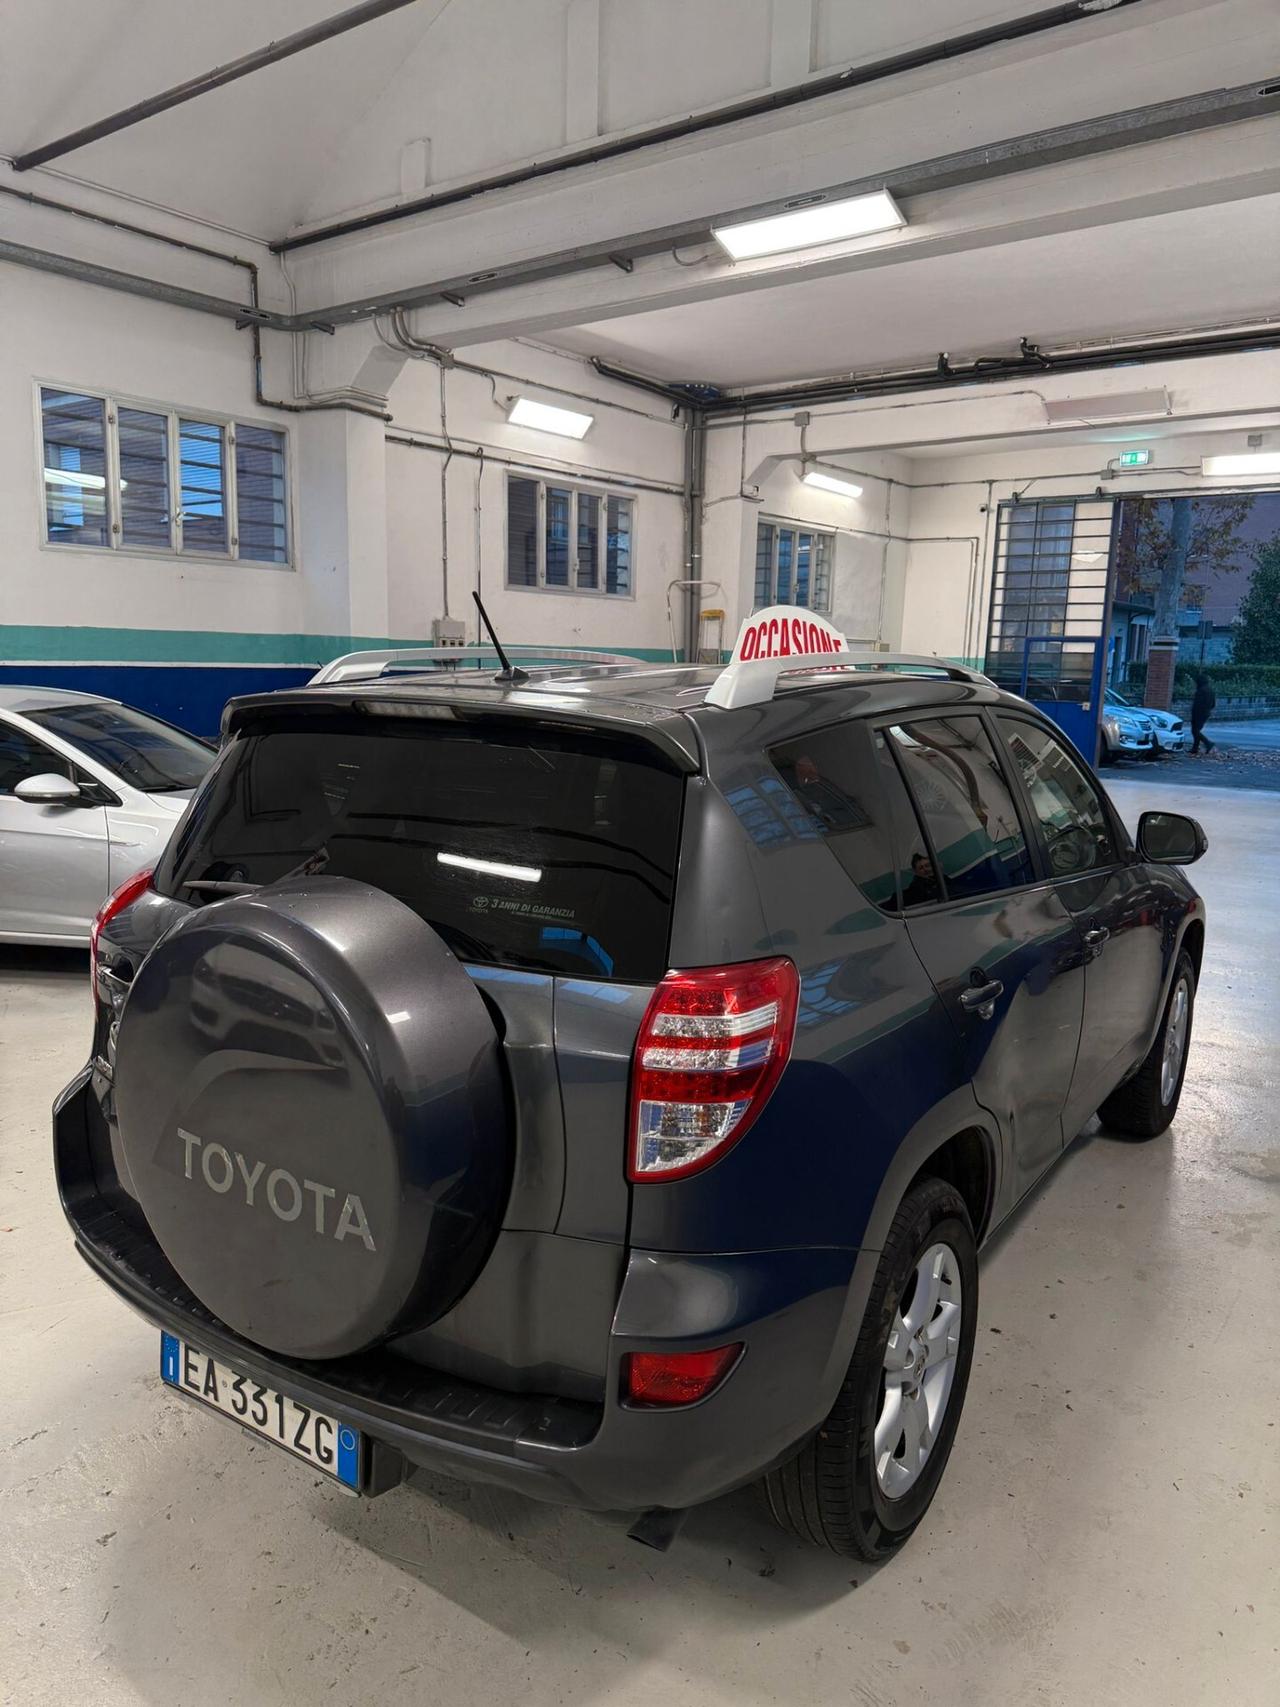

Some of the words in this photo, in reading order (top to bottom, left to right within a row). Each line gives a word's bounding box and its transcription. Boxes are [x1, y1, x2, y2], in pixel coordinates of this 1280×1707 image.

[491, 898, 500, 909] 3
[498, 900, 520, 912] ANNI
[520, 903, 531, 913] DI
[532, 905, 576, 919] GARANZIA
[177, 1127, 377, 1251] TOYOTA
[184, 1343, 219, 1402] EA
[231, 1370, 333, 1465] 331ZG
